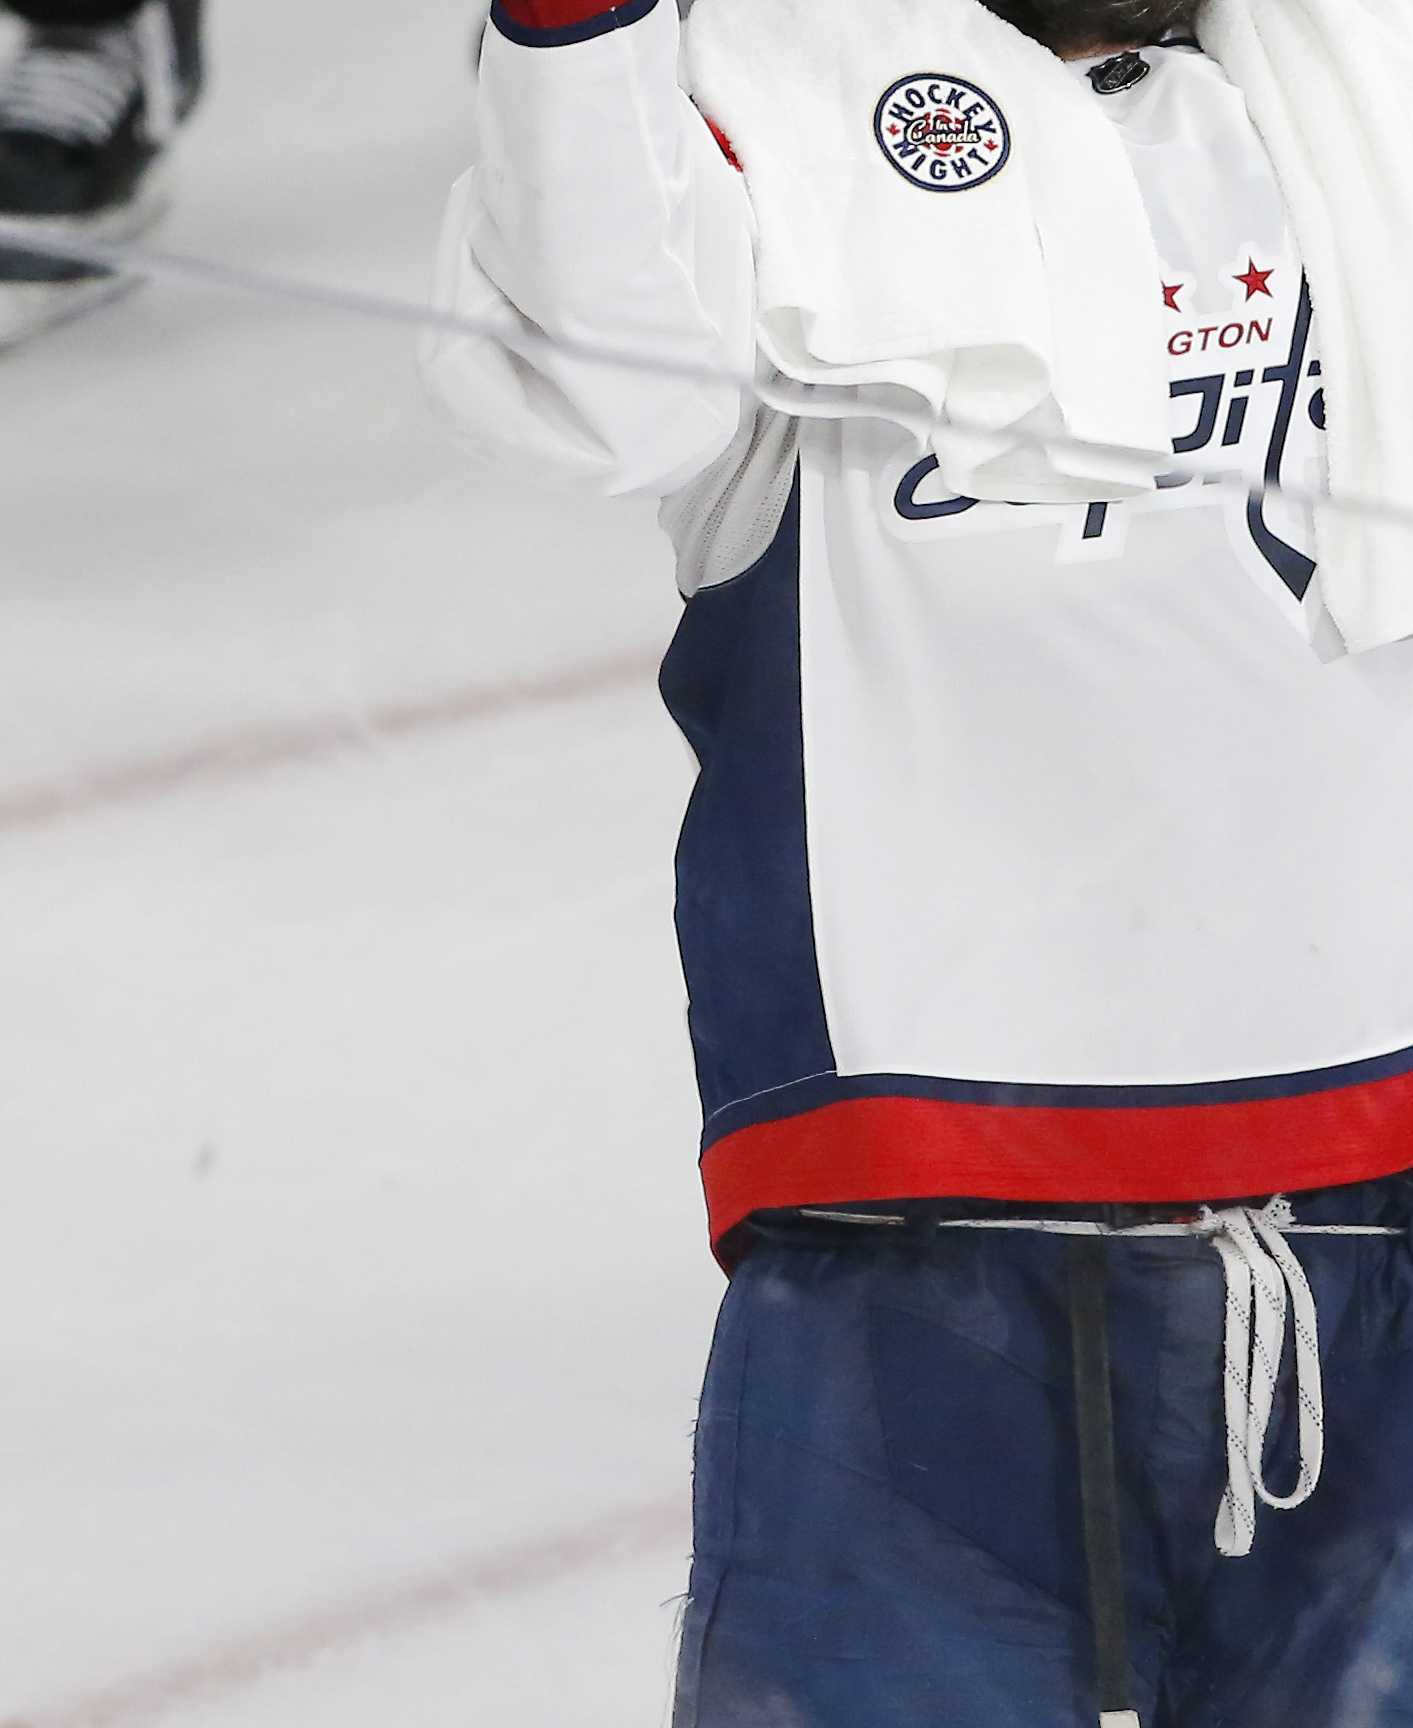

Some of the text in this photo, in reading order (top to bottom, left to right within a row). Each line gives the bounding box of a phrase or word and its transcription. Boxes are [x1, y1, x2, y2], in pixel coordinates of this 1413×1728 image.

[888, 83, 997, 134] HOCKEY
[911, 119, 980, 145] Canada
[892, 140, 989, 180] NIGHT
